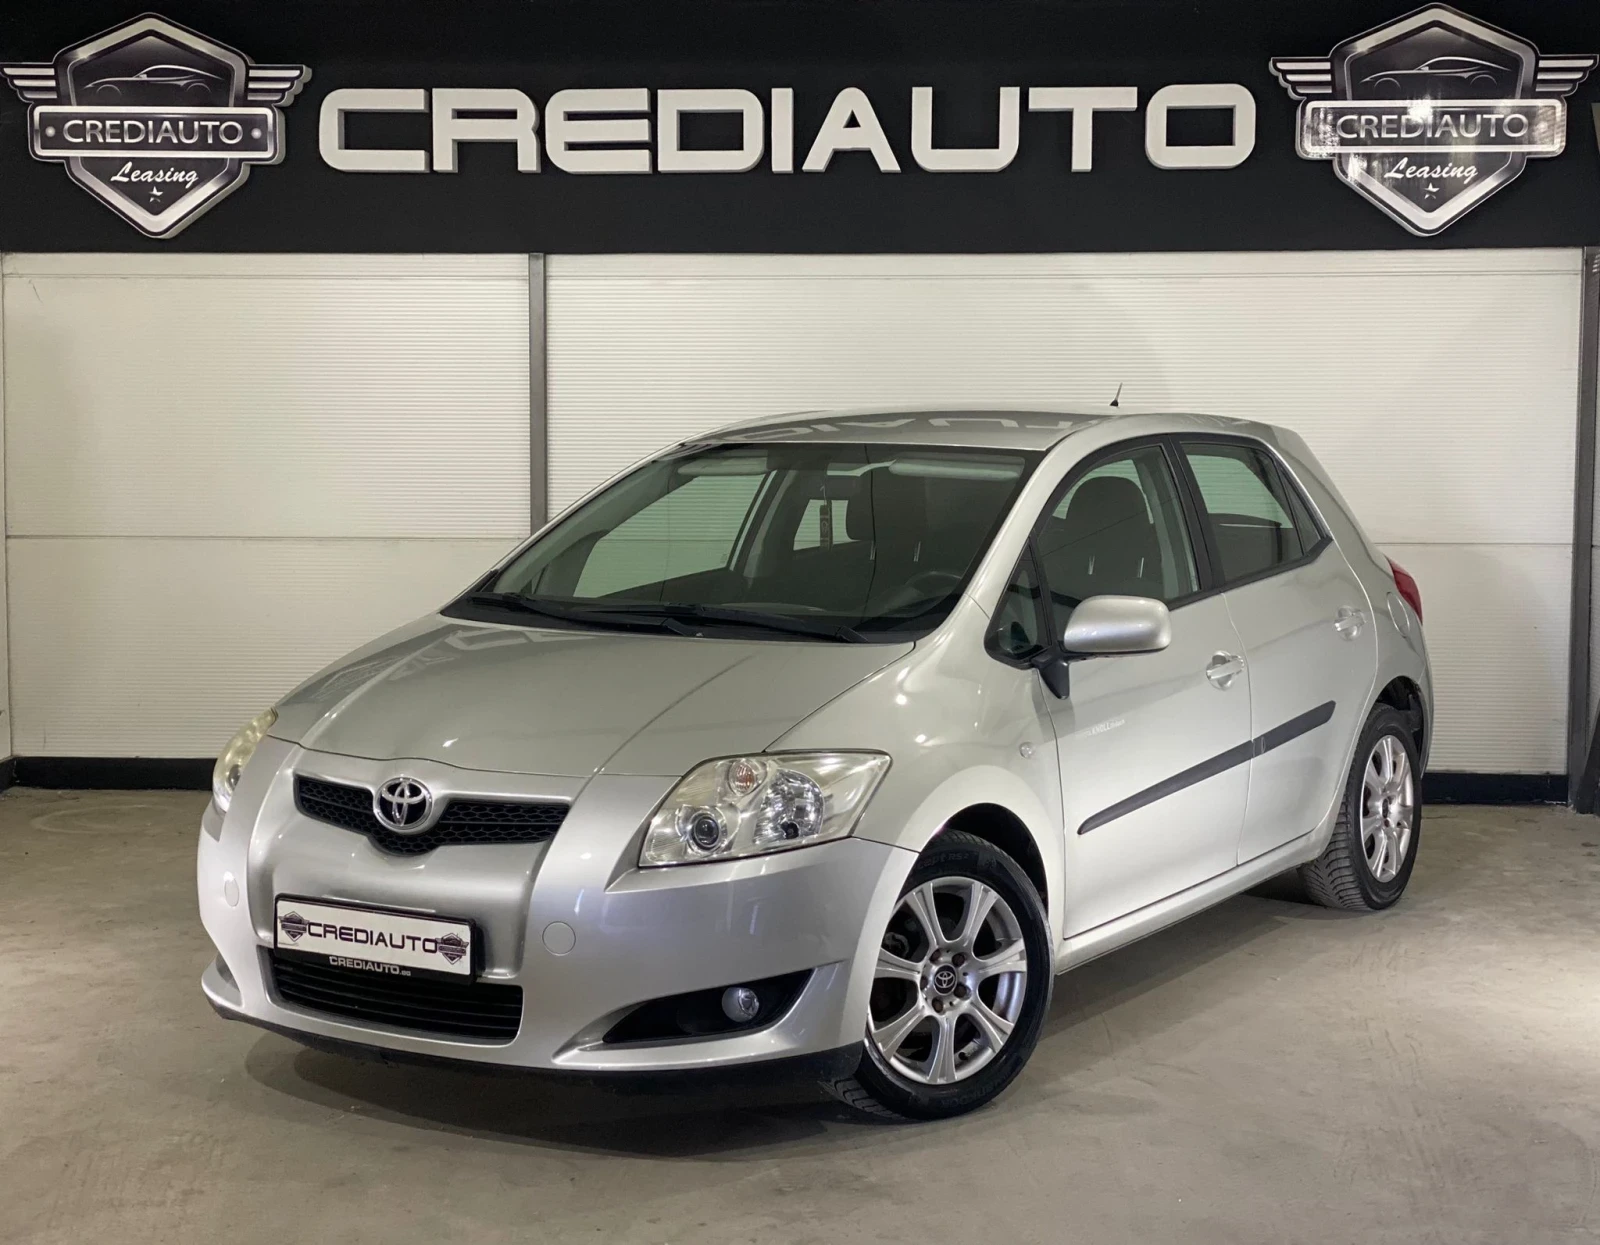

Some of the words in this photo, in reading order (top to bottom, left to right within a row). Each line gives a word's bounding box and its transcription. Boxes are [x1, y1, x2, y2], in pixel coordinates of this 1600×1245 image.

[63, 119, 243, 145] CREDIAUTO
[319, 83, 1256, 174] CREDIAUTO
[1336, 113, 1529, 139] CREDIAUTO
[110, 161, 199, 188] Leasing
[1384, 157, 1478, 183] Leasing
[308, 922, 438, 953] CREDIAUTO
